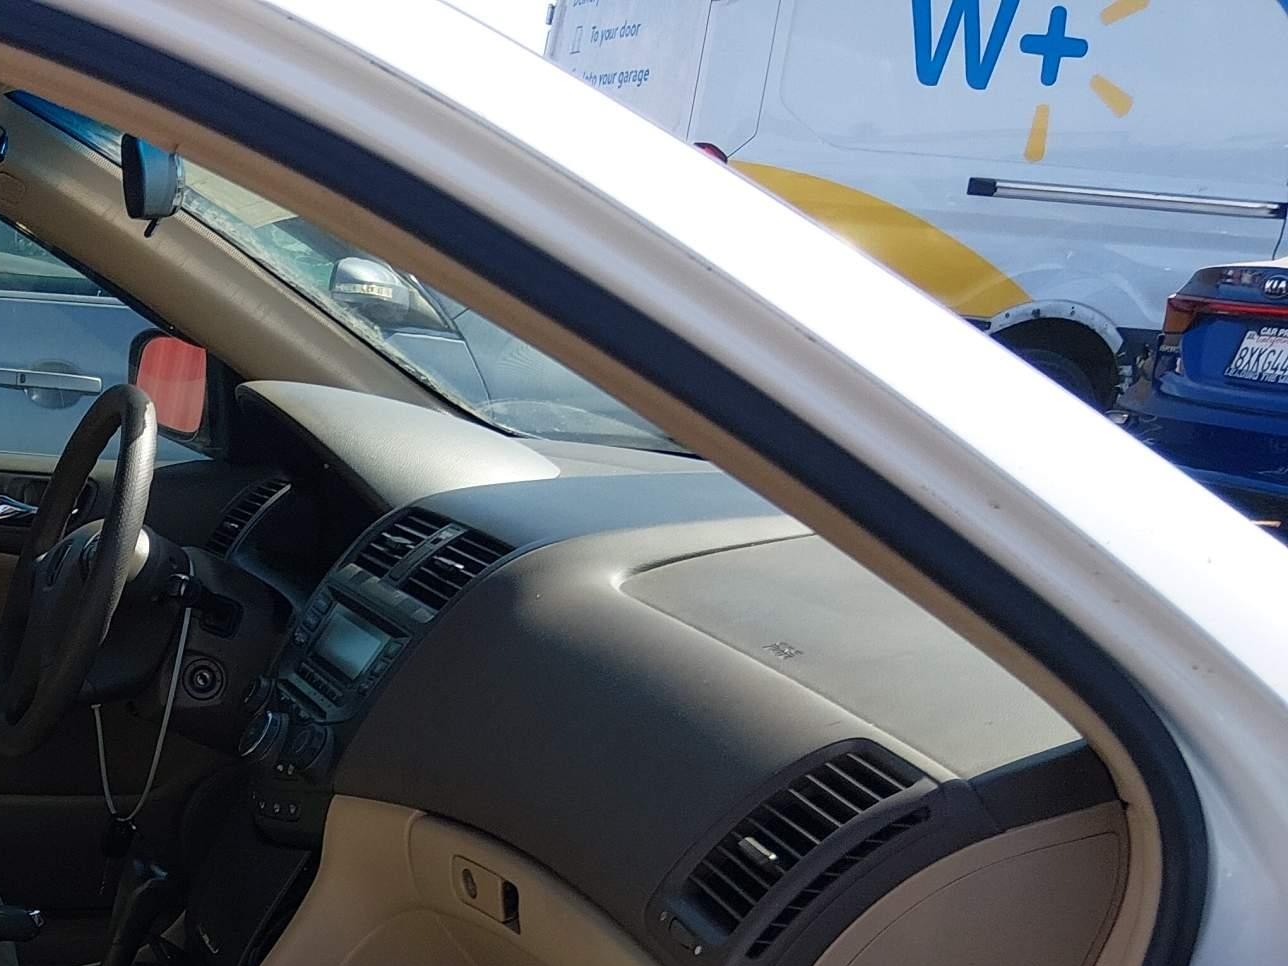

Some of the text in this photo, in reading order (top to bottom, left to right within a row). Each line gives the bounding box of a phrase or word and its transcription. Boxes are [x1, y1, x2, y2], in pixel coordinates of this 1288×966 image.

[590, 20, 642, 48] To your door
[911, 0, 1089, 90] W+
[597, 71, 616, 87] your
[617, 68, 650, 89] garage
[1265, 279, 1287, 292] KIA
[1260, 327, 1278, 336] CAR
